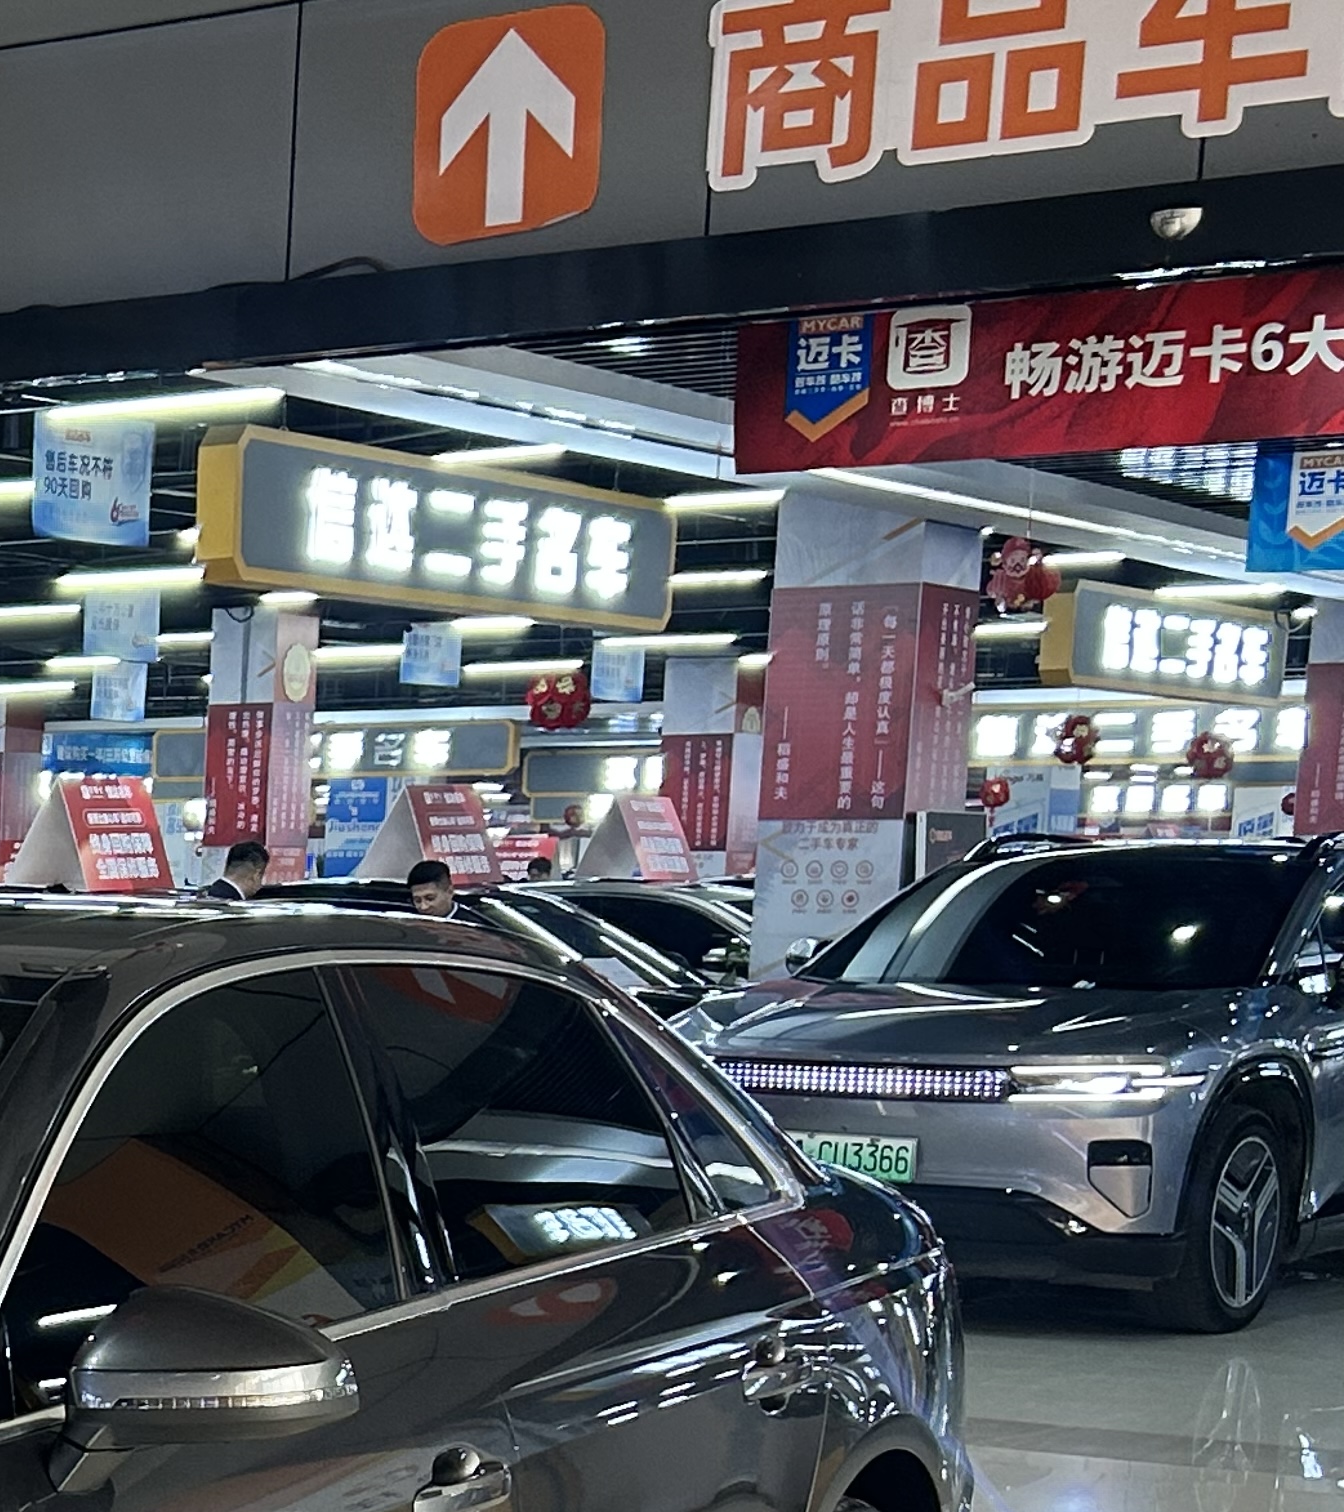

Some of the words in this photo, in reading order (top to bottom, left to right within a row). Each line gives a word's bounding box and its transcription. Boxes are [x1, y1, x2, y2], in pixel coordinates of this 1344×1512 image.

[721, 0, 1309, 178] 商品车
[801, 316, 862, 334] MYCAR
[797, 334, 863, 372] 迈卡
[1005, 314, 1344, 400] 畅游迈卡6大
[889, 393, 961, 417] 查博士
